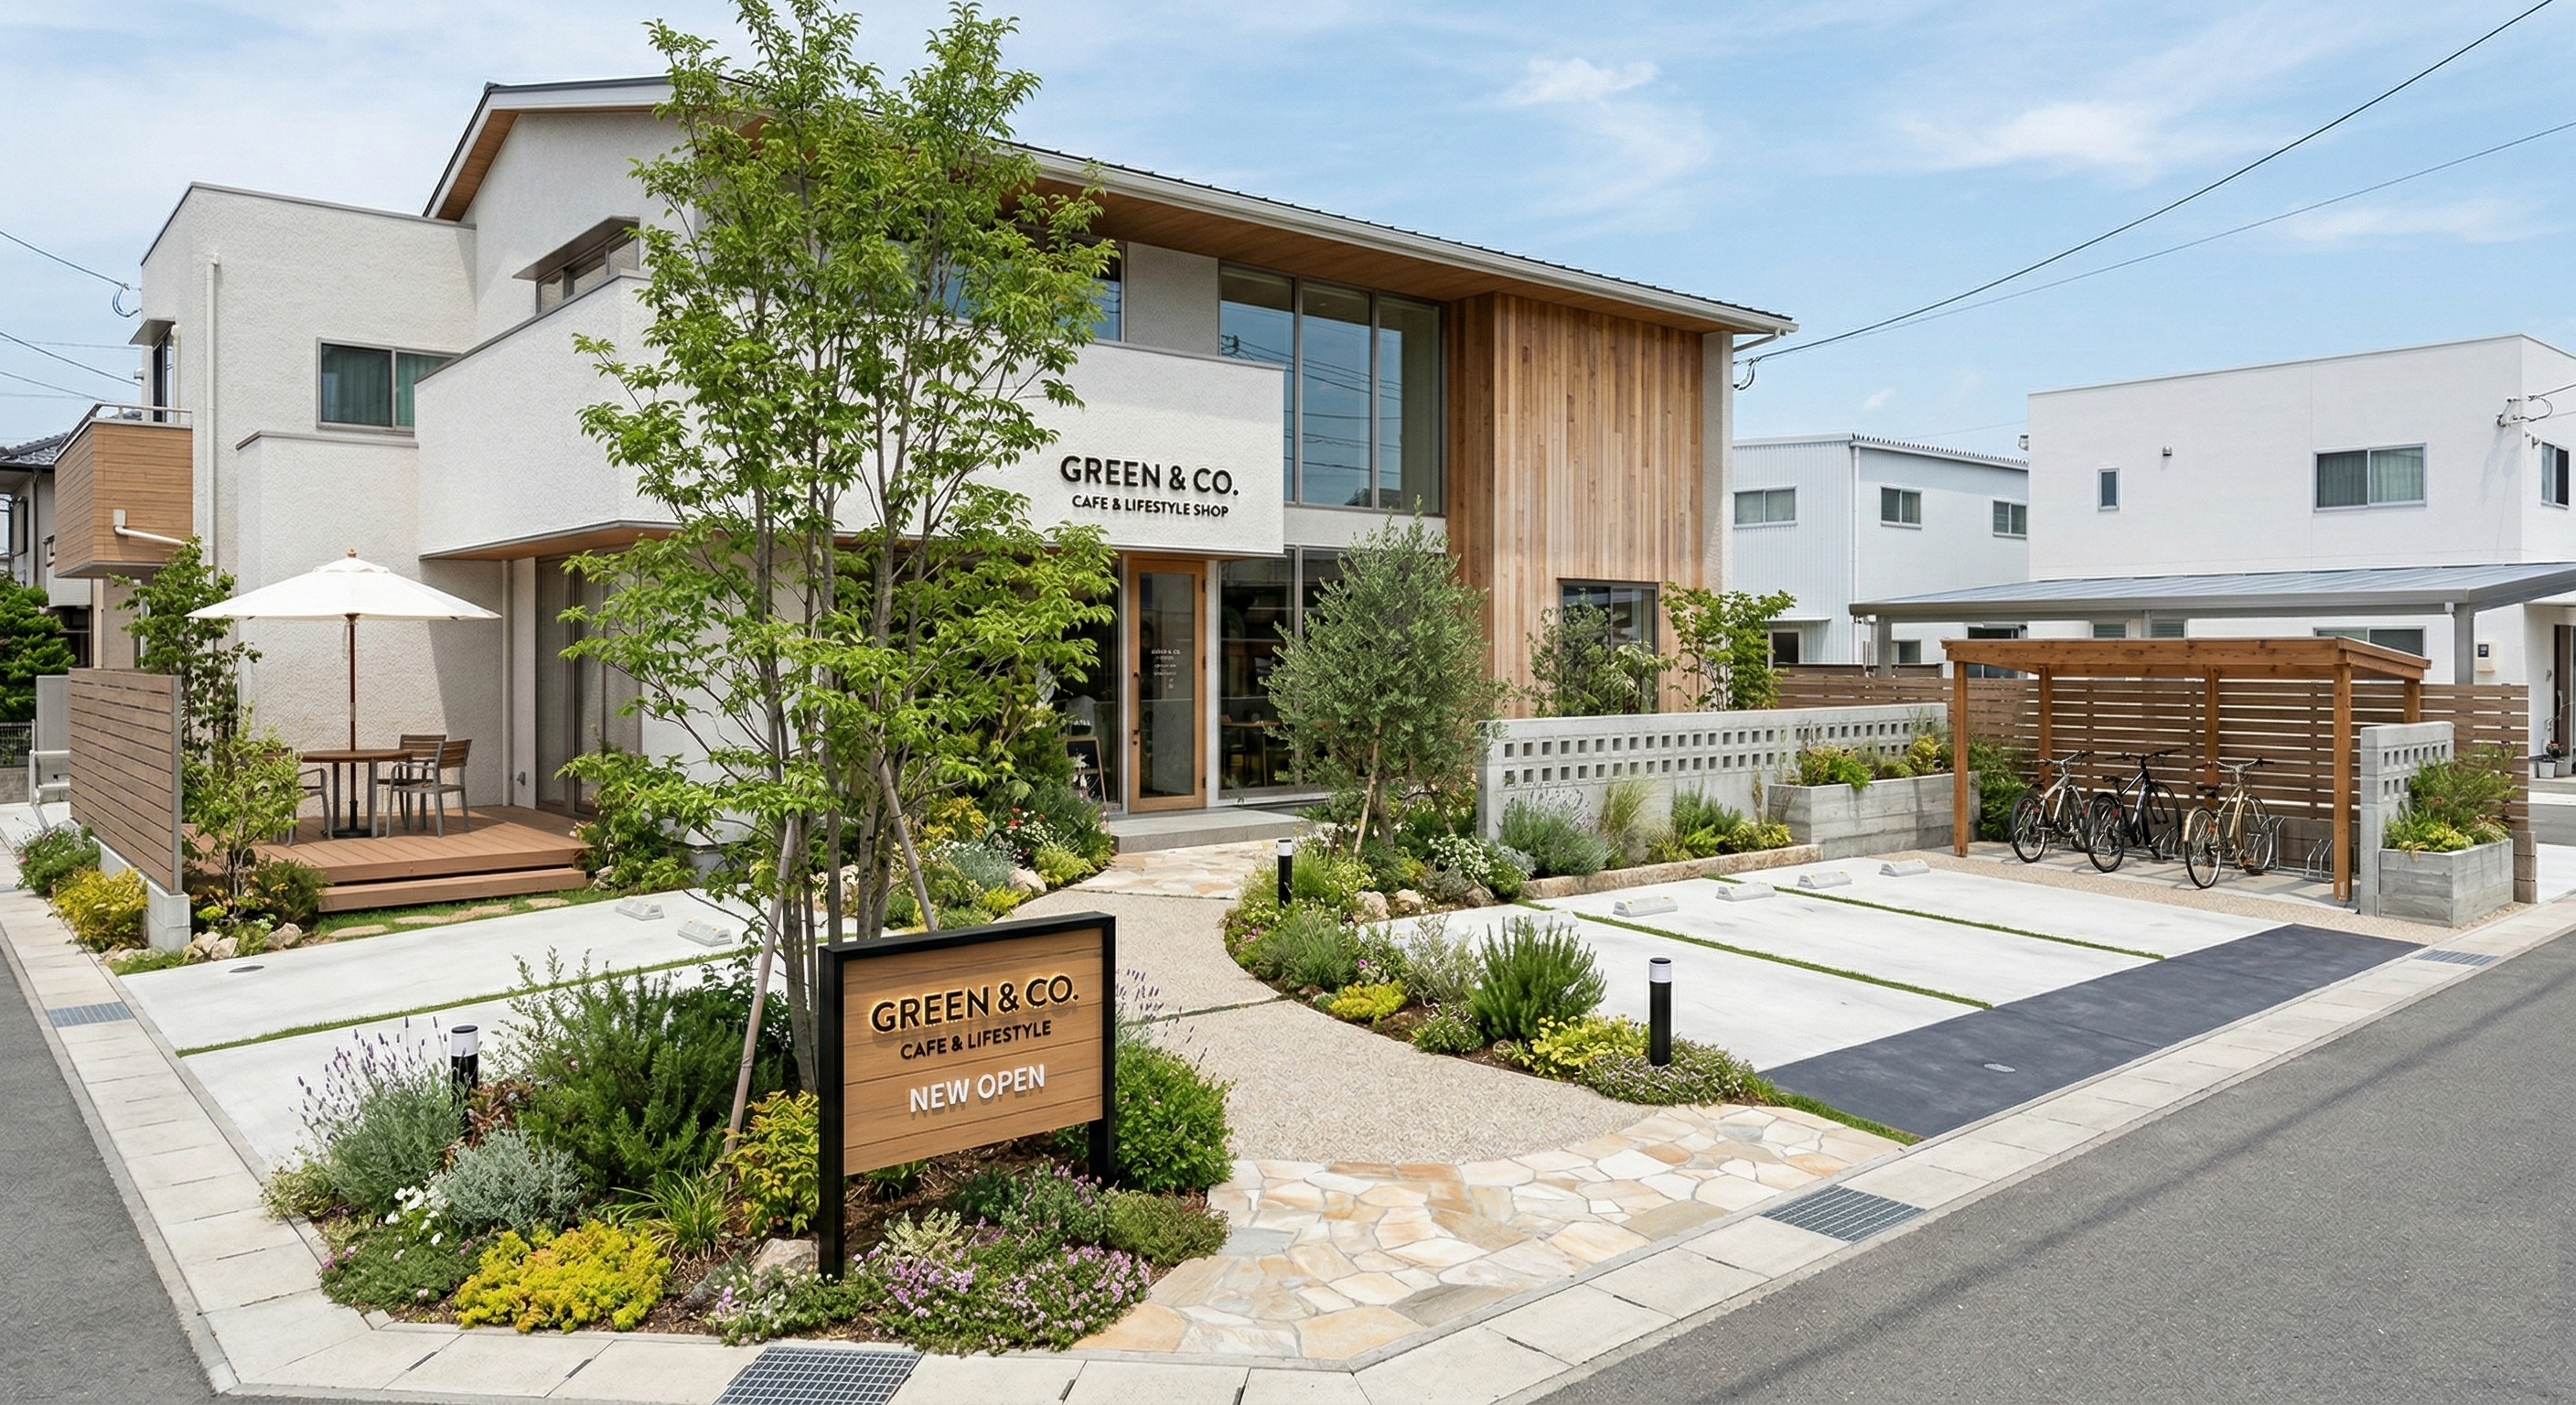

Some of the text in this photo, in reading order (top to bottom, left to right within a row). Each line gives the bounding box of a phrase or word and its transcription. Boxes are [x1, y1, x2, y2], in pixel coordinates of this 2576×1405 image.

[1060, 456, 1239, 496] GREEN & CO.
[1072, 494, 1229, 518] CAFE & LIFESTYLE SHOP
[871, 975, 1079, 1032] GREEN & CO.
[900, 1020, 1051, 1060] CAFE & LIFESTYLE
[909, 1064, 1046, 1113] NEW OPEN
